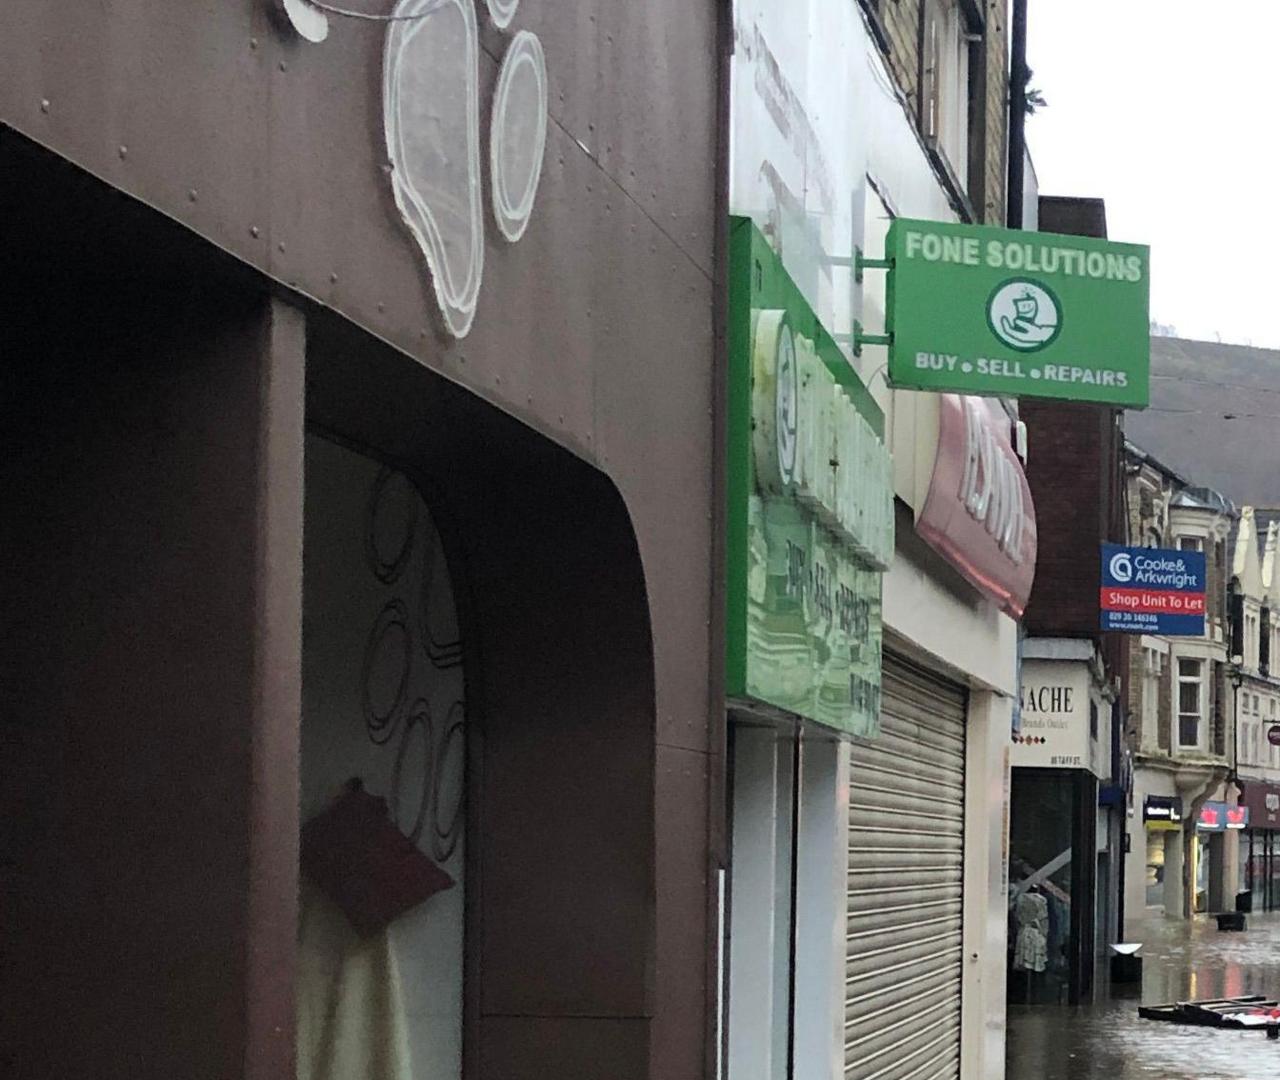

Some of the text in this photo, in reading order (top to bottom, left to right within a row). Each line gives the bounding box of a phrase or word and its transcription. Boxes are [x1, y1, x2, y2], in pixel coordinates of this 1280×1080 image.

[905, 231, 1142, 282] FONE SOLUTIONS
[915, 352, 1129, 388] BUY SELL REPAIRS
[1135, 570, 1198, 588] Arkwright
[1109, 592, 1203, 609] Shop Unit To Let
